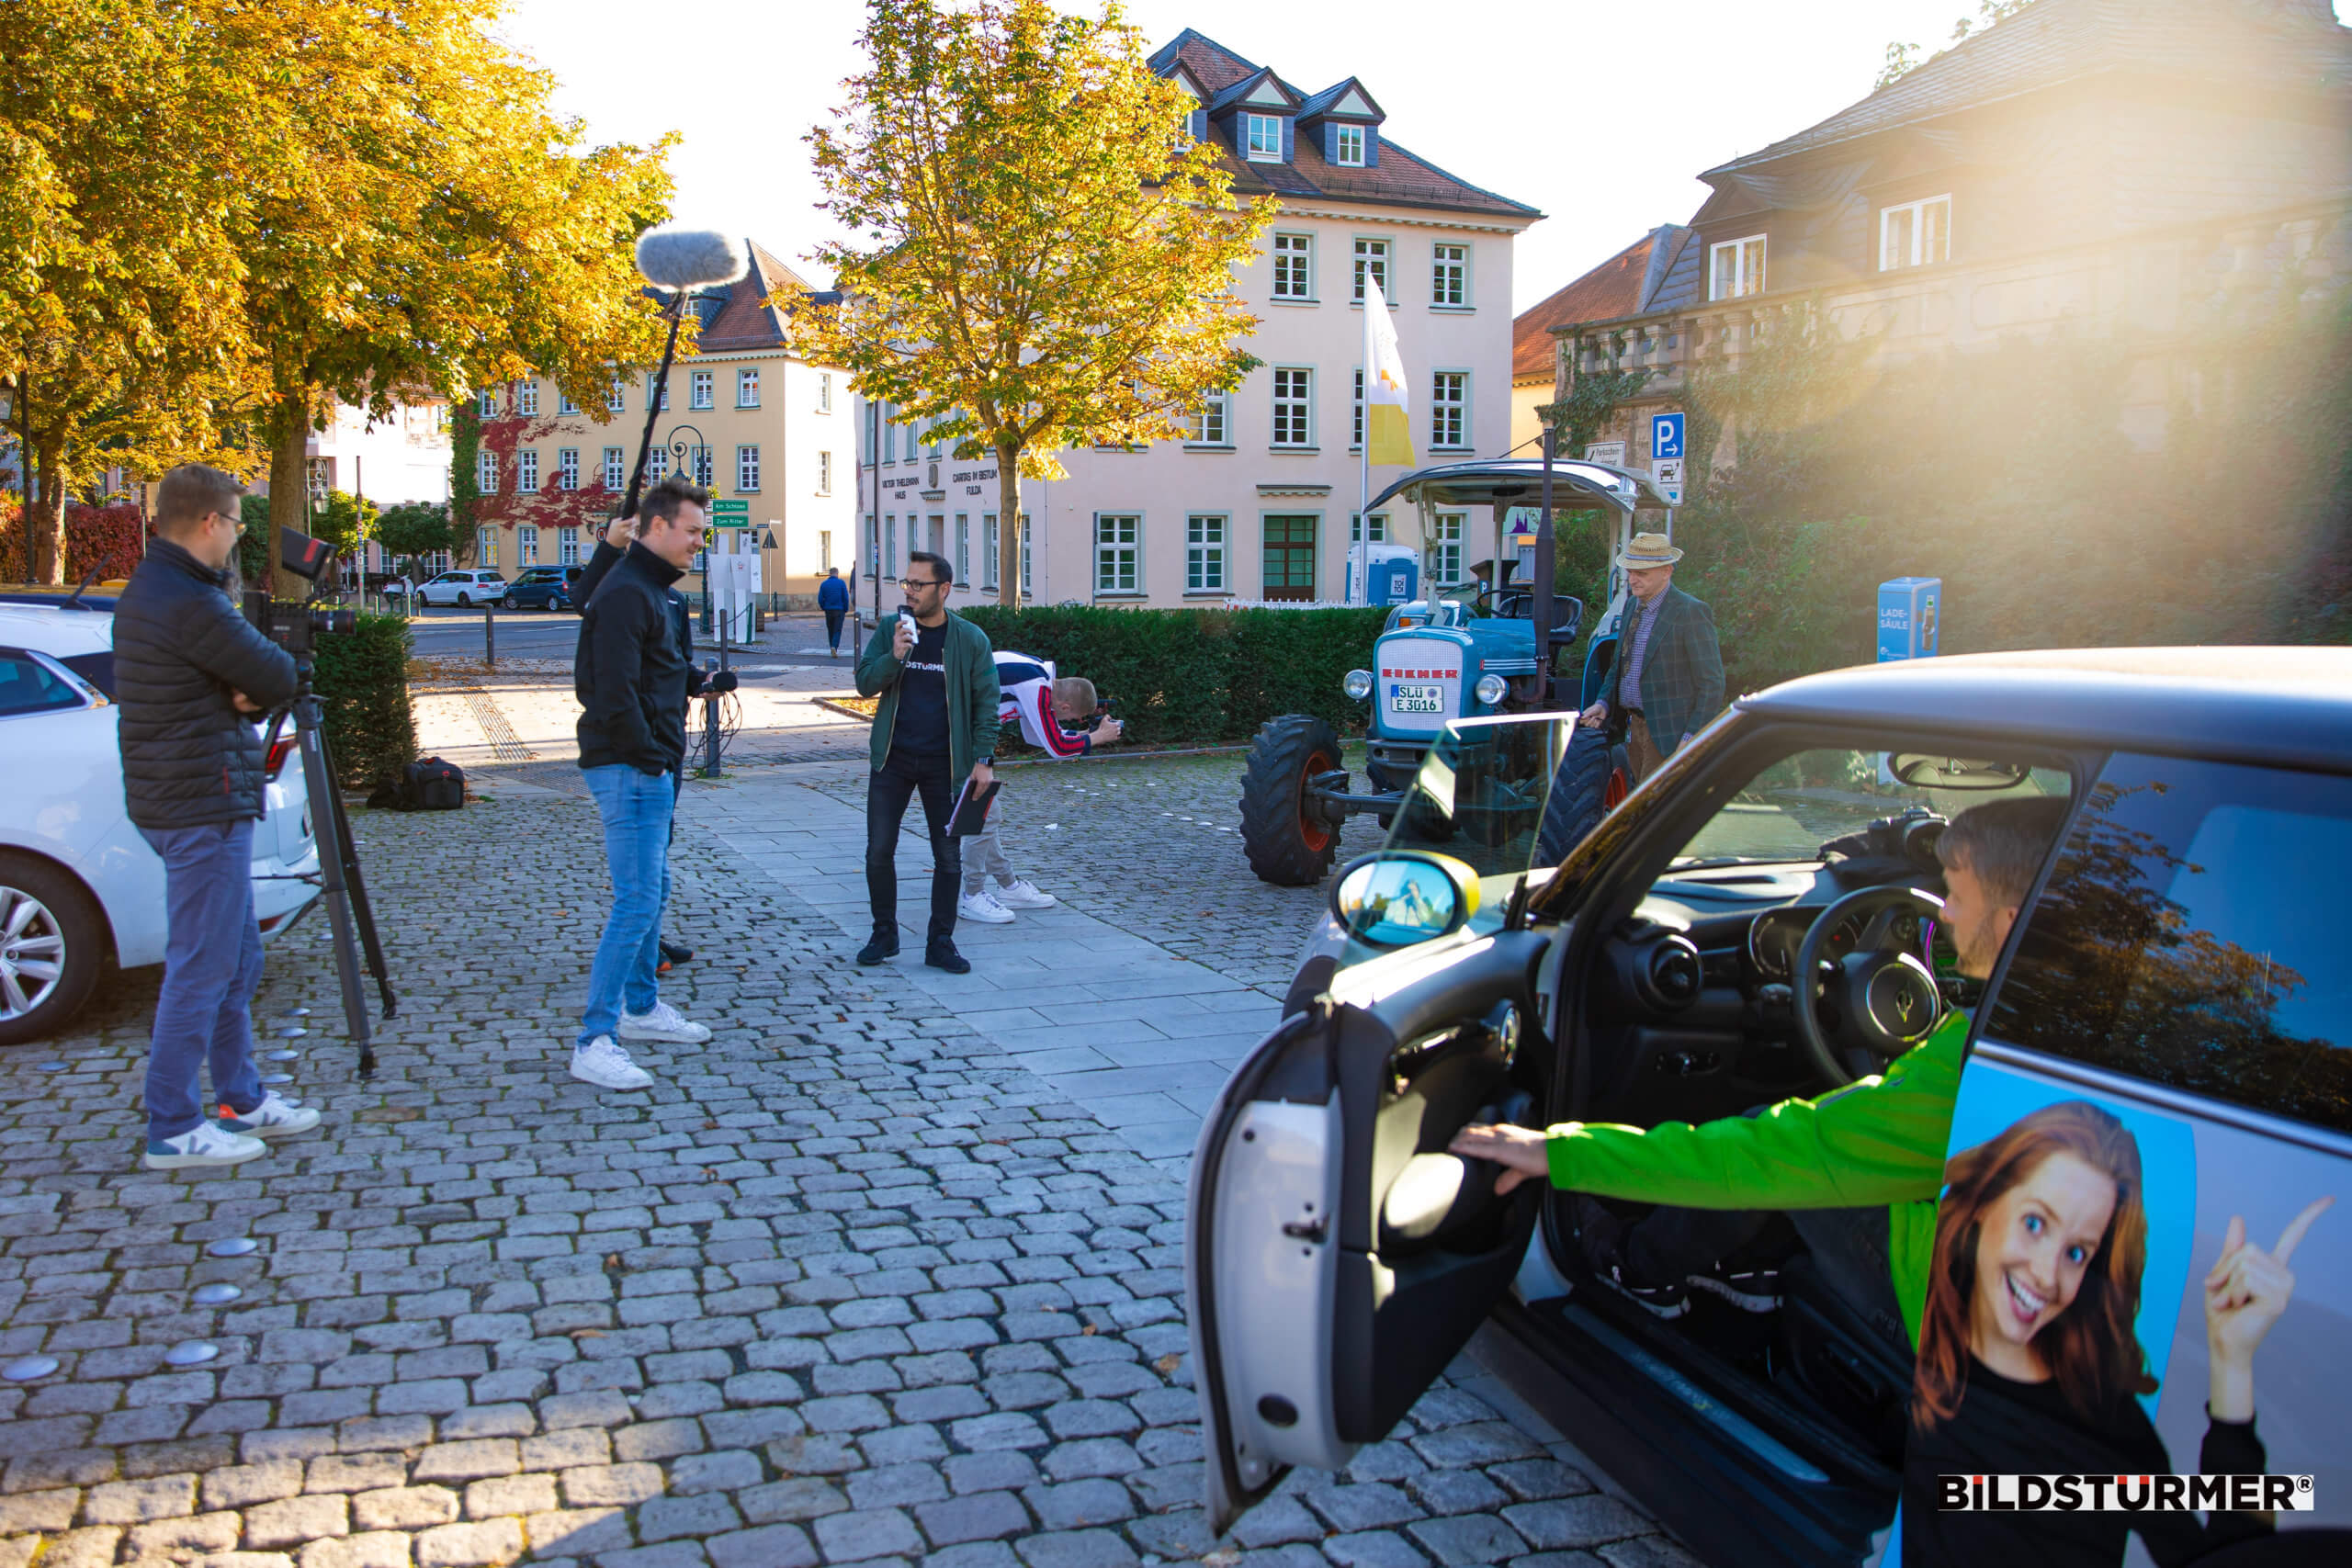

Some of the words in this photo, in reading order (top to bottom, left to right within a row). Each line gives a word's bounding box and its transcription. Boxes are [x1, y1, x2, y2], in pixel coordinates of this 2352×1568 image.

[1657, 421, 1674, 456] P
[895, 491, 906, 500] HAUS
[966, 485, 982, 496] FULDA
[1881, 609, 1907, 617] LADE-
[1881, 618, 1908, 629] SÄULE
[1399, 687, 1423, 698] SLÜ
[1396, 700, 1404, 710] E
[1407, 700, 1437, 711] 3016
